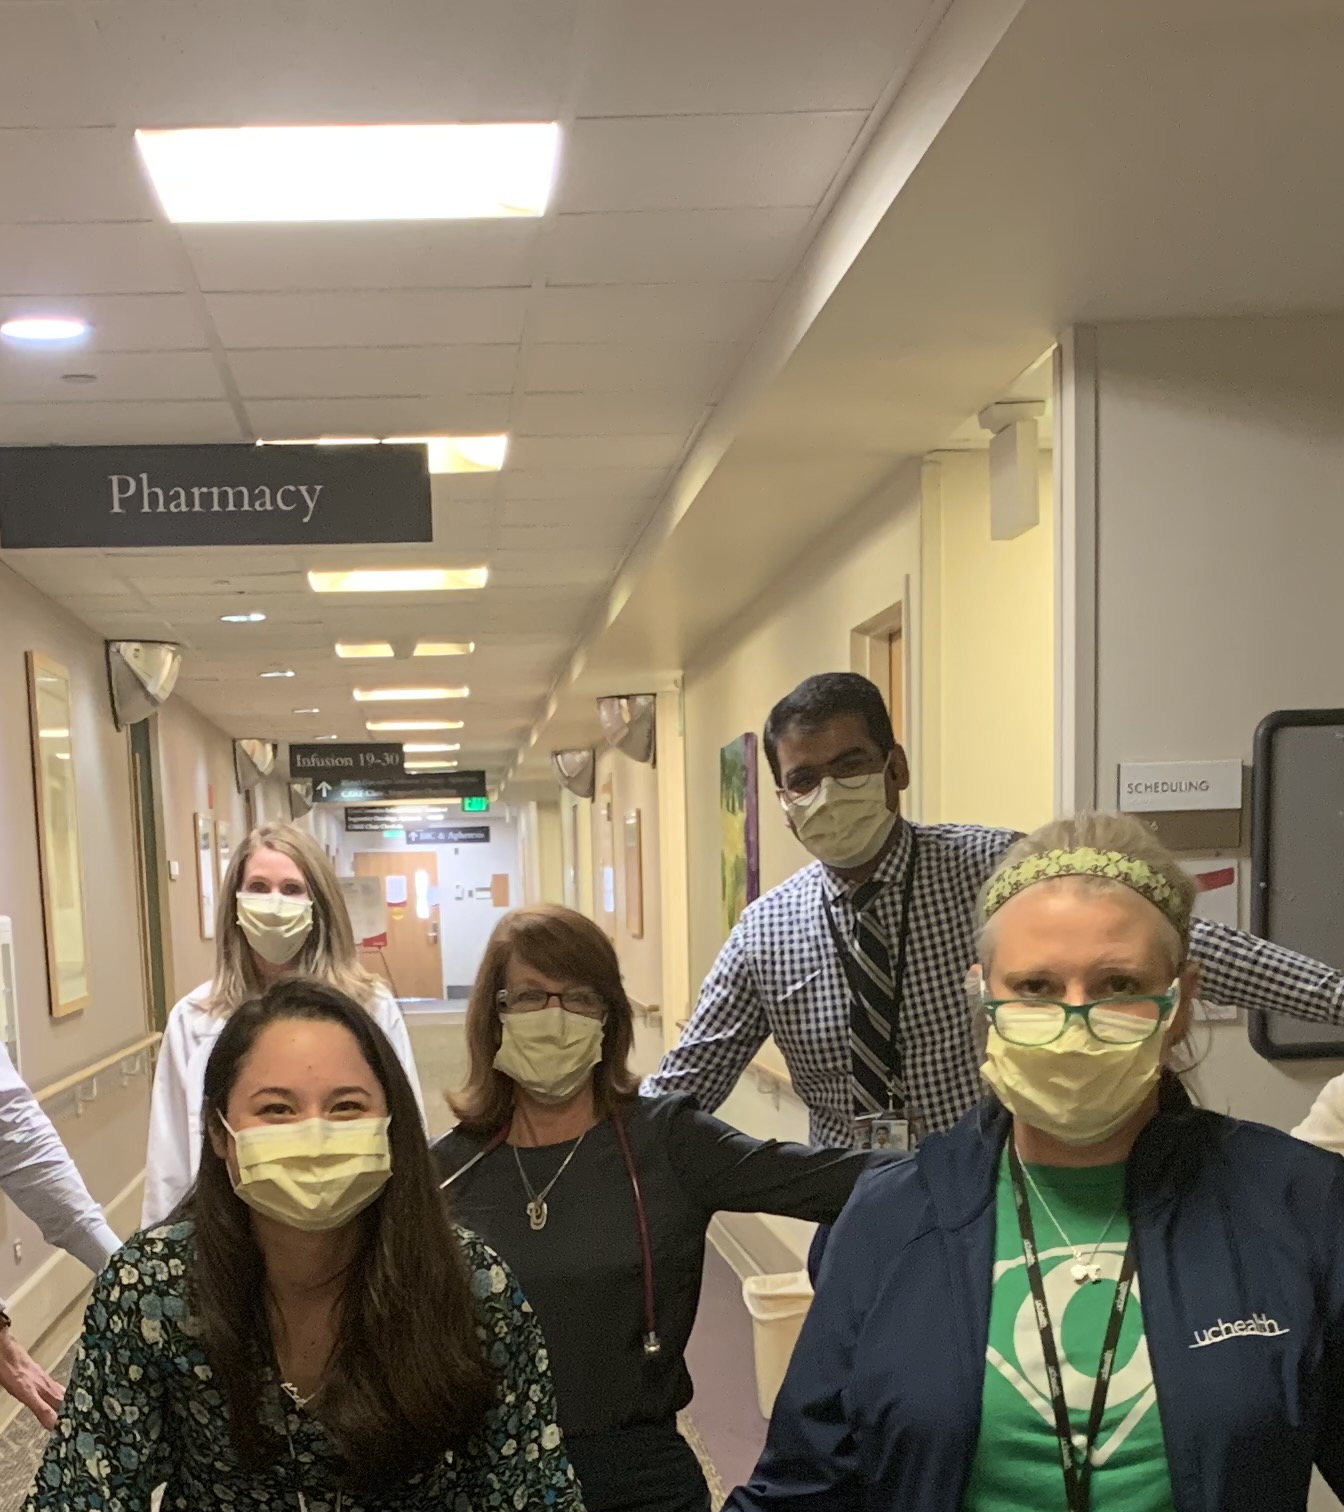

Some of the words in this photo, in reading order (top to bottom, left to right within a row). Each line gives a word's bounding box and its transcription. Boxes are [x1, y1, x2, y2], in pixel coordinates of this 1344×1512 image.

[108, 472, 324, 523] Pharmacy
[296, 752, 354, 768] Infusion
[360, 751, 400, 767] 19-30
[1126, 780, 1210, 795] SCHEDULING
[1193, 1312, 1281, 1344] uchealth
